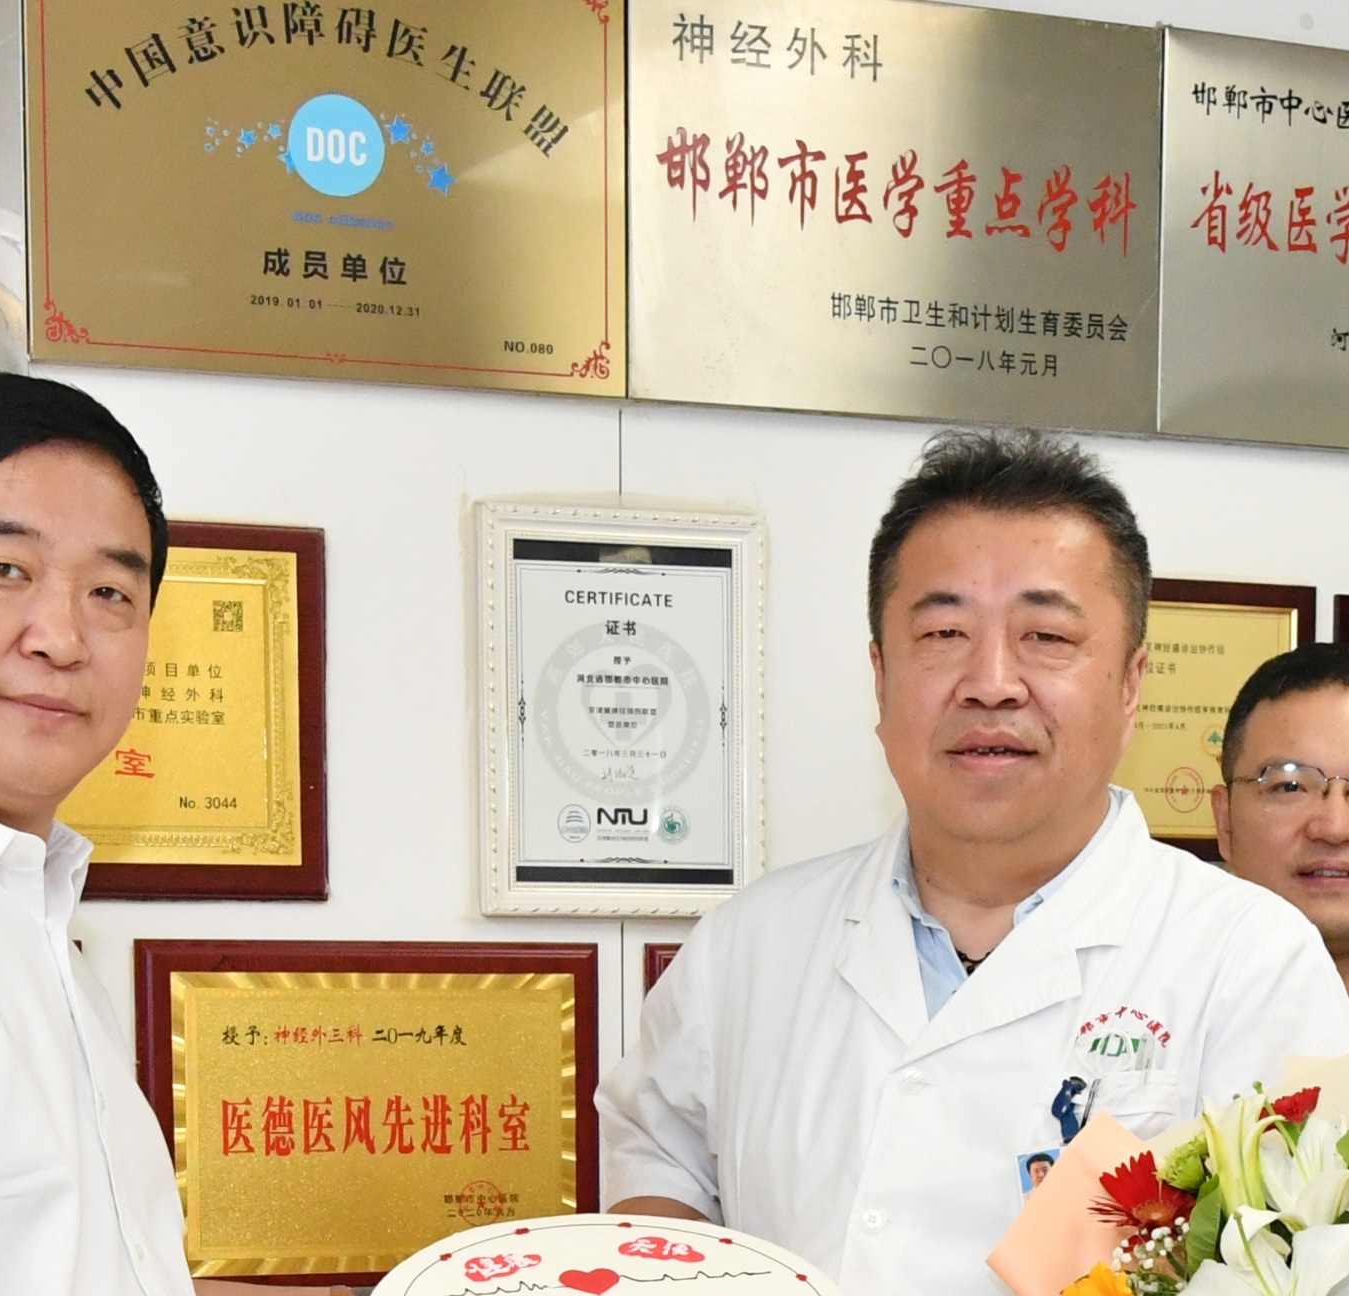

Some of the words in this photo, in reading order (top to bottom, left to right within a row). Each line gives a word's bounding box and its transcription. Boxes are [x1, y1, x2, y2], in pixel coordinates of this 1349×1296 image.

[672, 13, 884, 83] 神经外科
[85, 1, 570, 159] 中国意识障碍医生联盟
[305, 126, 368, 167] DOC
[656, 126, 1138, 257] 邯郸市医学重点学科
[262, 247, 408, 286] 成员单位
[830, 291, 1130, 342] 邯郸市卫生和计划生育委员会
[504, 340, 554, 355] NO.080
[564, 589, 673, 608] CERTIFICATE
[605, 619, 637, 636] 证书
[115, 748, 156, 779] 室
[205, 796, 238, 809] 3044
[221, 1093, 531, 1158] 医德医风先进科室
